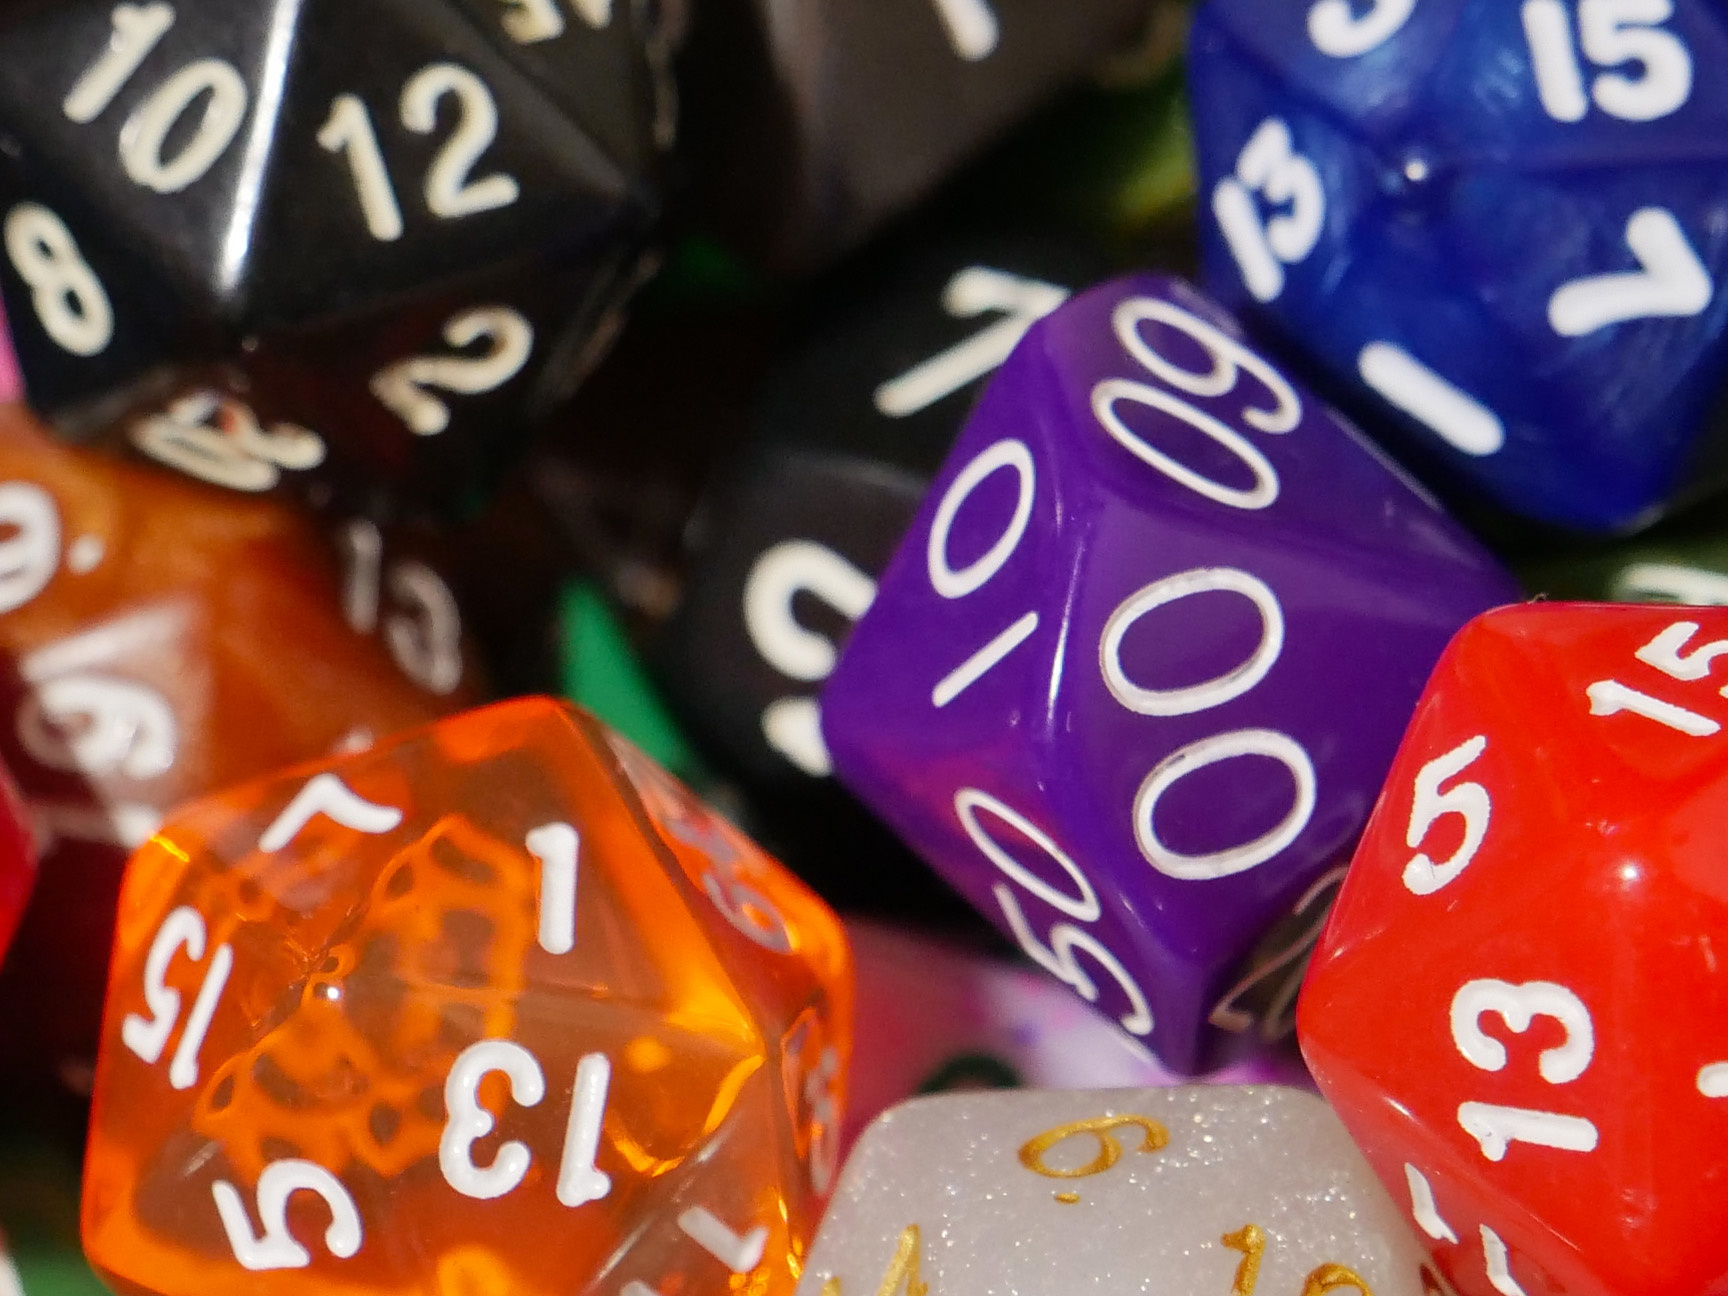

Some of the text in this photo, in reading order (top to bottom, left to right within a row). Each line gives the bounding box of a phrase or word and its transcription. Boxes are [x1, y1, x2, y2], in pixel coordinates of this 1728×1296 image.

[62, 4, 248, 194] 10
[317, 62, 521, 243] 12
[5, 200, 116, 357] 8
[1212, 114, 1326, 304] 13
[1545, 204, 1716, 338] 7
[370, 304, 536, 436] 2
[1357, 340, 1506, 457] 1
[927, 437, 1040, 709] 10
[1097, 565, 1318, 882] 00
[257, 773, 405, 854] 7
[524, 820, 581, 956] 1
[1401, 734, 1494, 898] 5
[952, 784, 1156, 1038] 50
[121, 904, 234, 1092] 15
[1449, 976, 1600, 1164] 13
[436, 1039, 614, 1209] 13
[209, 1156, 365, 1273] 5
